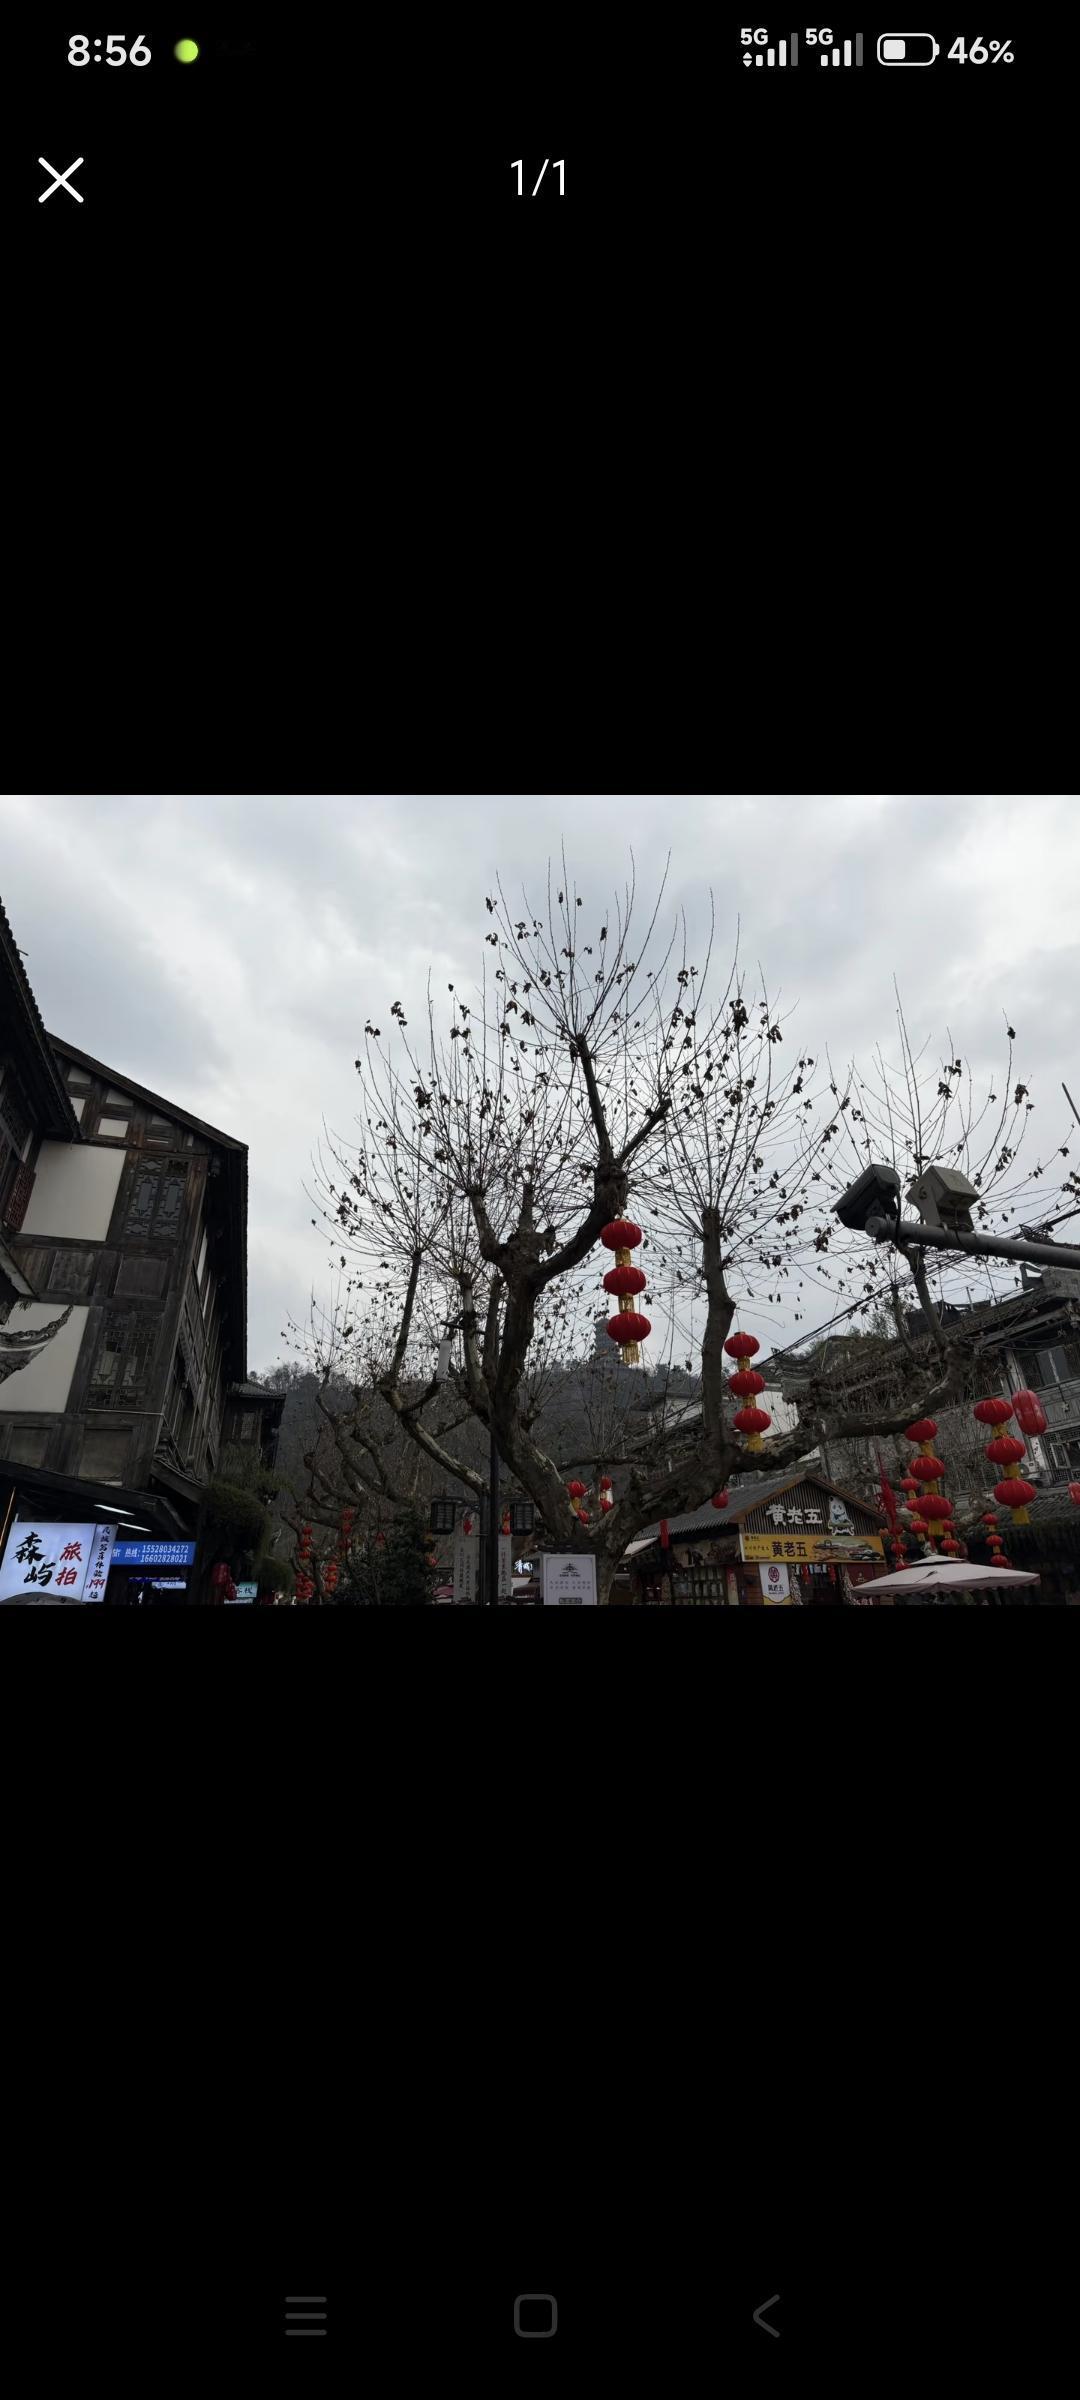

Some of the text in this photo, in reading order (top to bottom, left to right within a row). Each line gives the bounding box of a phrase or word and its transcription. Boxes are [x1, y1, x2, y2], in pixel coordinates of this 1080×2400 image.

[766, 1504, 823, 1526] 黄老五
[11, 1531, 56, 1587] 森屿
[140, 1554, 188, 1563] 16602828021
[142, 1545, 189, 1554] 15528034272
[771, 1540, 808, 1558] 黄老五
[55, 1541, 82, 1586] 旅拍
